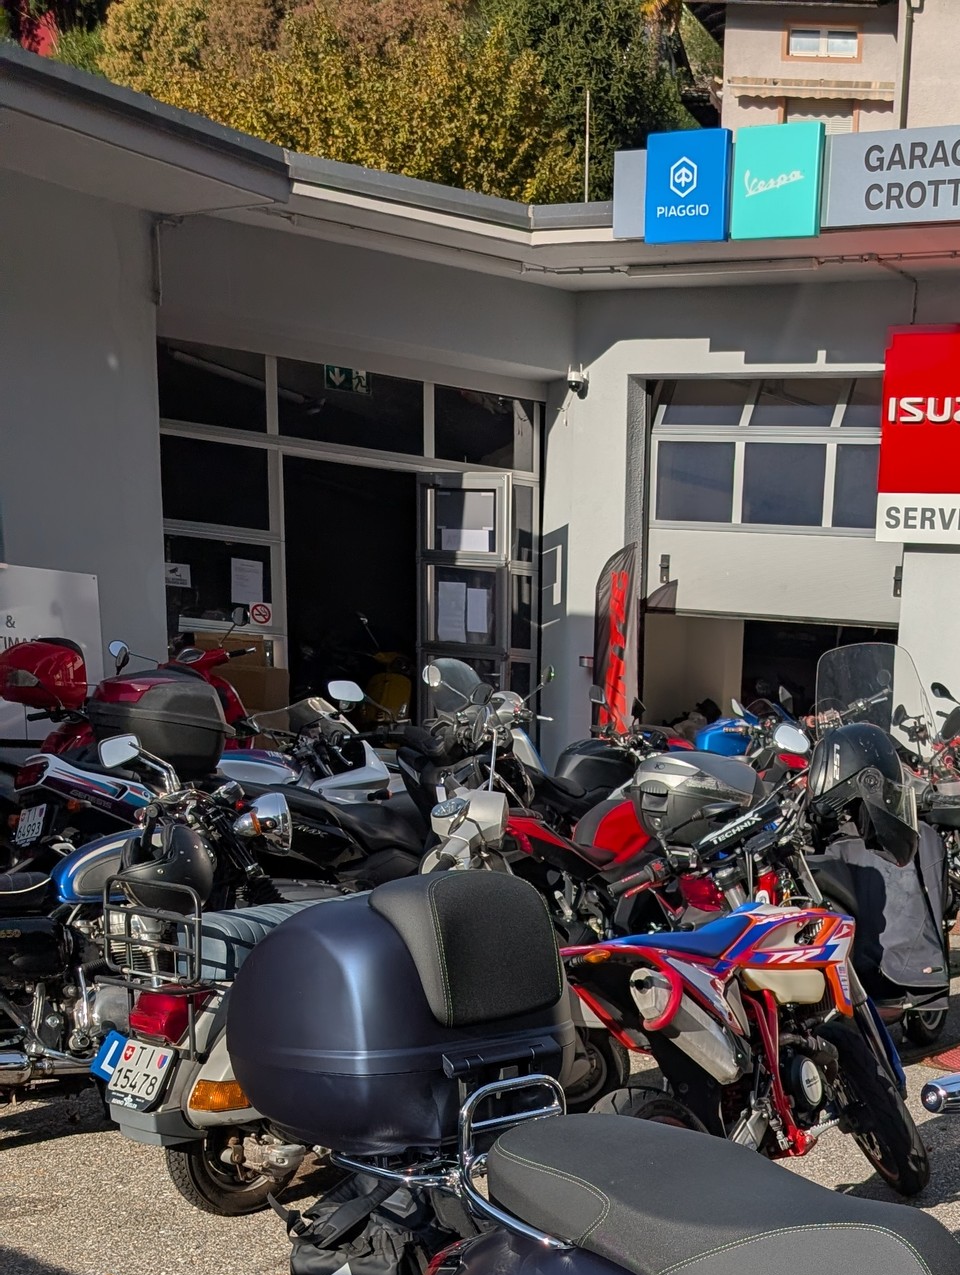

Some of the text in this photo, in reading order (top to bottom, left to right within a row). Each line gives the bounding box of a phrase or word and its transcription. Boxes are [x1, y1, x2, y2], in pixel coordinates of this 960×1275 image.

[744, 169, 804, 198] Vespa
[656, 203, 710, 218] PIAGGIO
[5, 615, 16, 629] &
[833, 743, 841, 781] LS2
[709, 813, 763, 845] TECHNIX
[100, 1040, 120, 1075] L
[135, 1046, 156, 1070] TI
[113, 1067, 158, 1096] 15478
